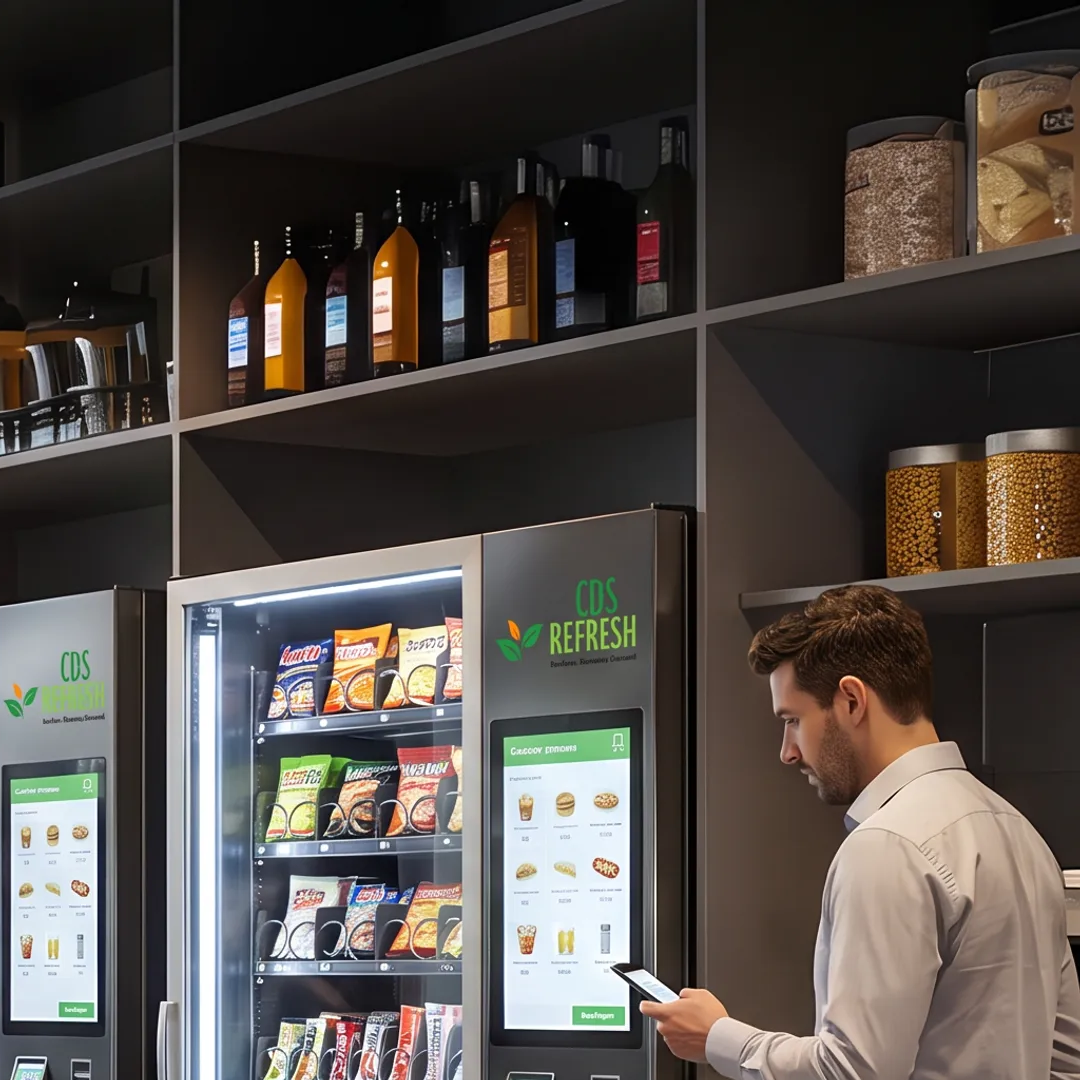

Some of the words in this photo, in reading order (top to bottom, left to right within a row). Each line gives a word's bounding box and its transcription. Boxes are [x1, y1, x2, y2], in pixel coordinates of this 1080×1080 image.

[575, 576, 618, 617] CDS
[549, 614, 637, 655] REFRESH
[60, 649, 91, 682] CDS
[41, 681, 105, 713] REFRESH
